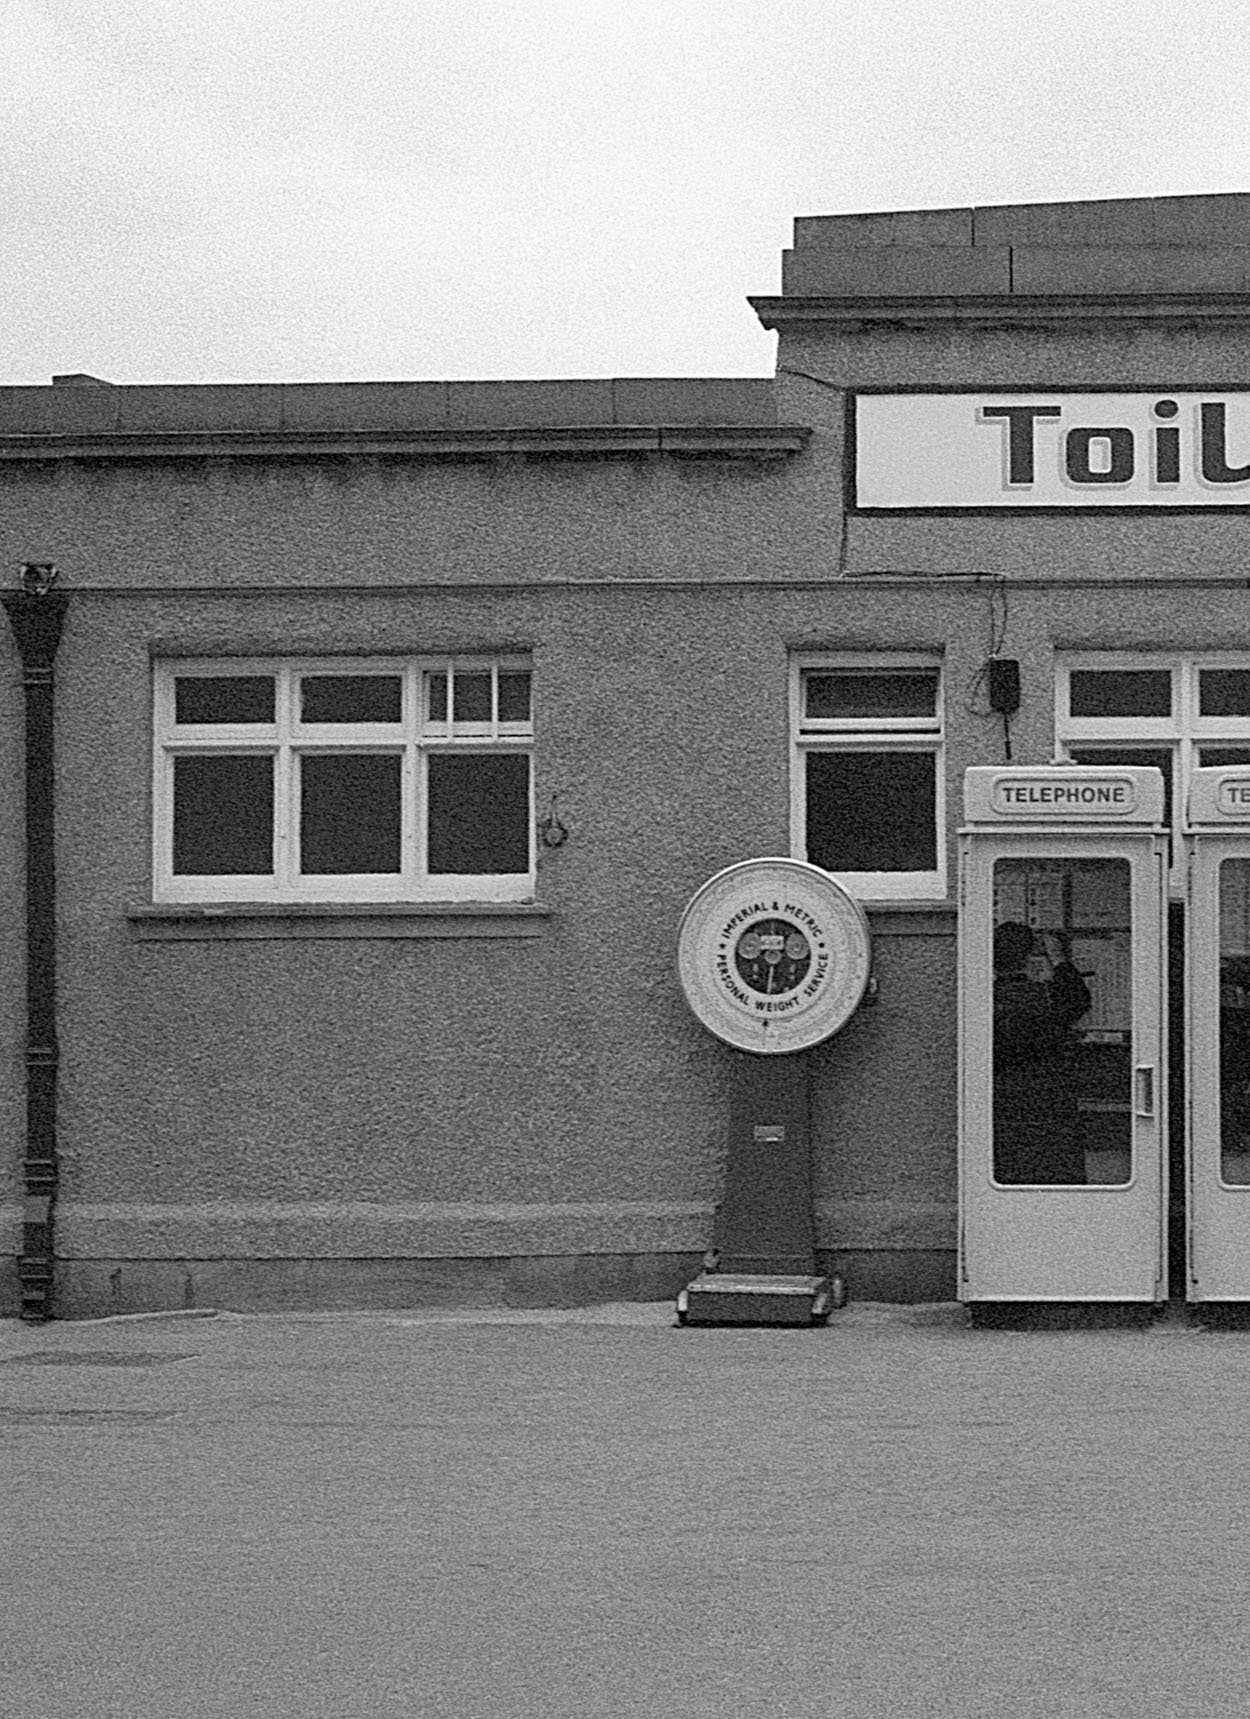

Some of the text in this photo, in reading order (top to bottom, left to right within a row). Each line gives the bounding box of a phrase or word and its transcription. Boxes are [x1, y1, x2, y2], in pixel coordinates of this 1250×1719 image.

[1002, 786, 1125, 804] TELEPHONE
[721, 901, 823, 939] IMPERIAL & METRIC
[717, 953, 829, 1012] PERSONAL WEIGHT SERVICE
